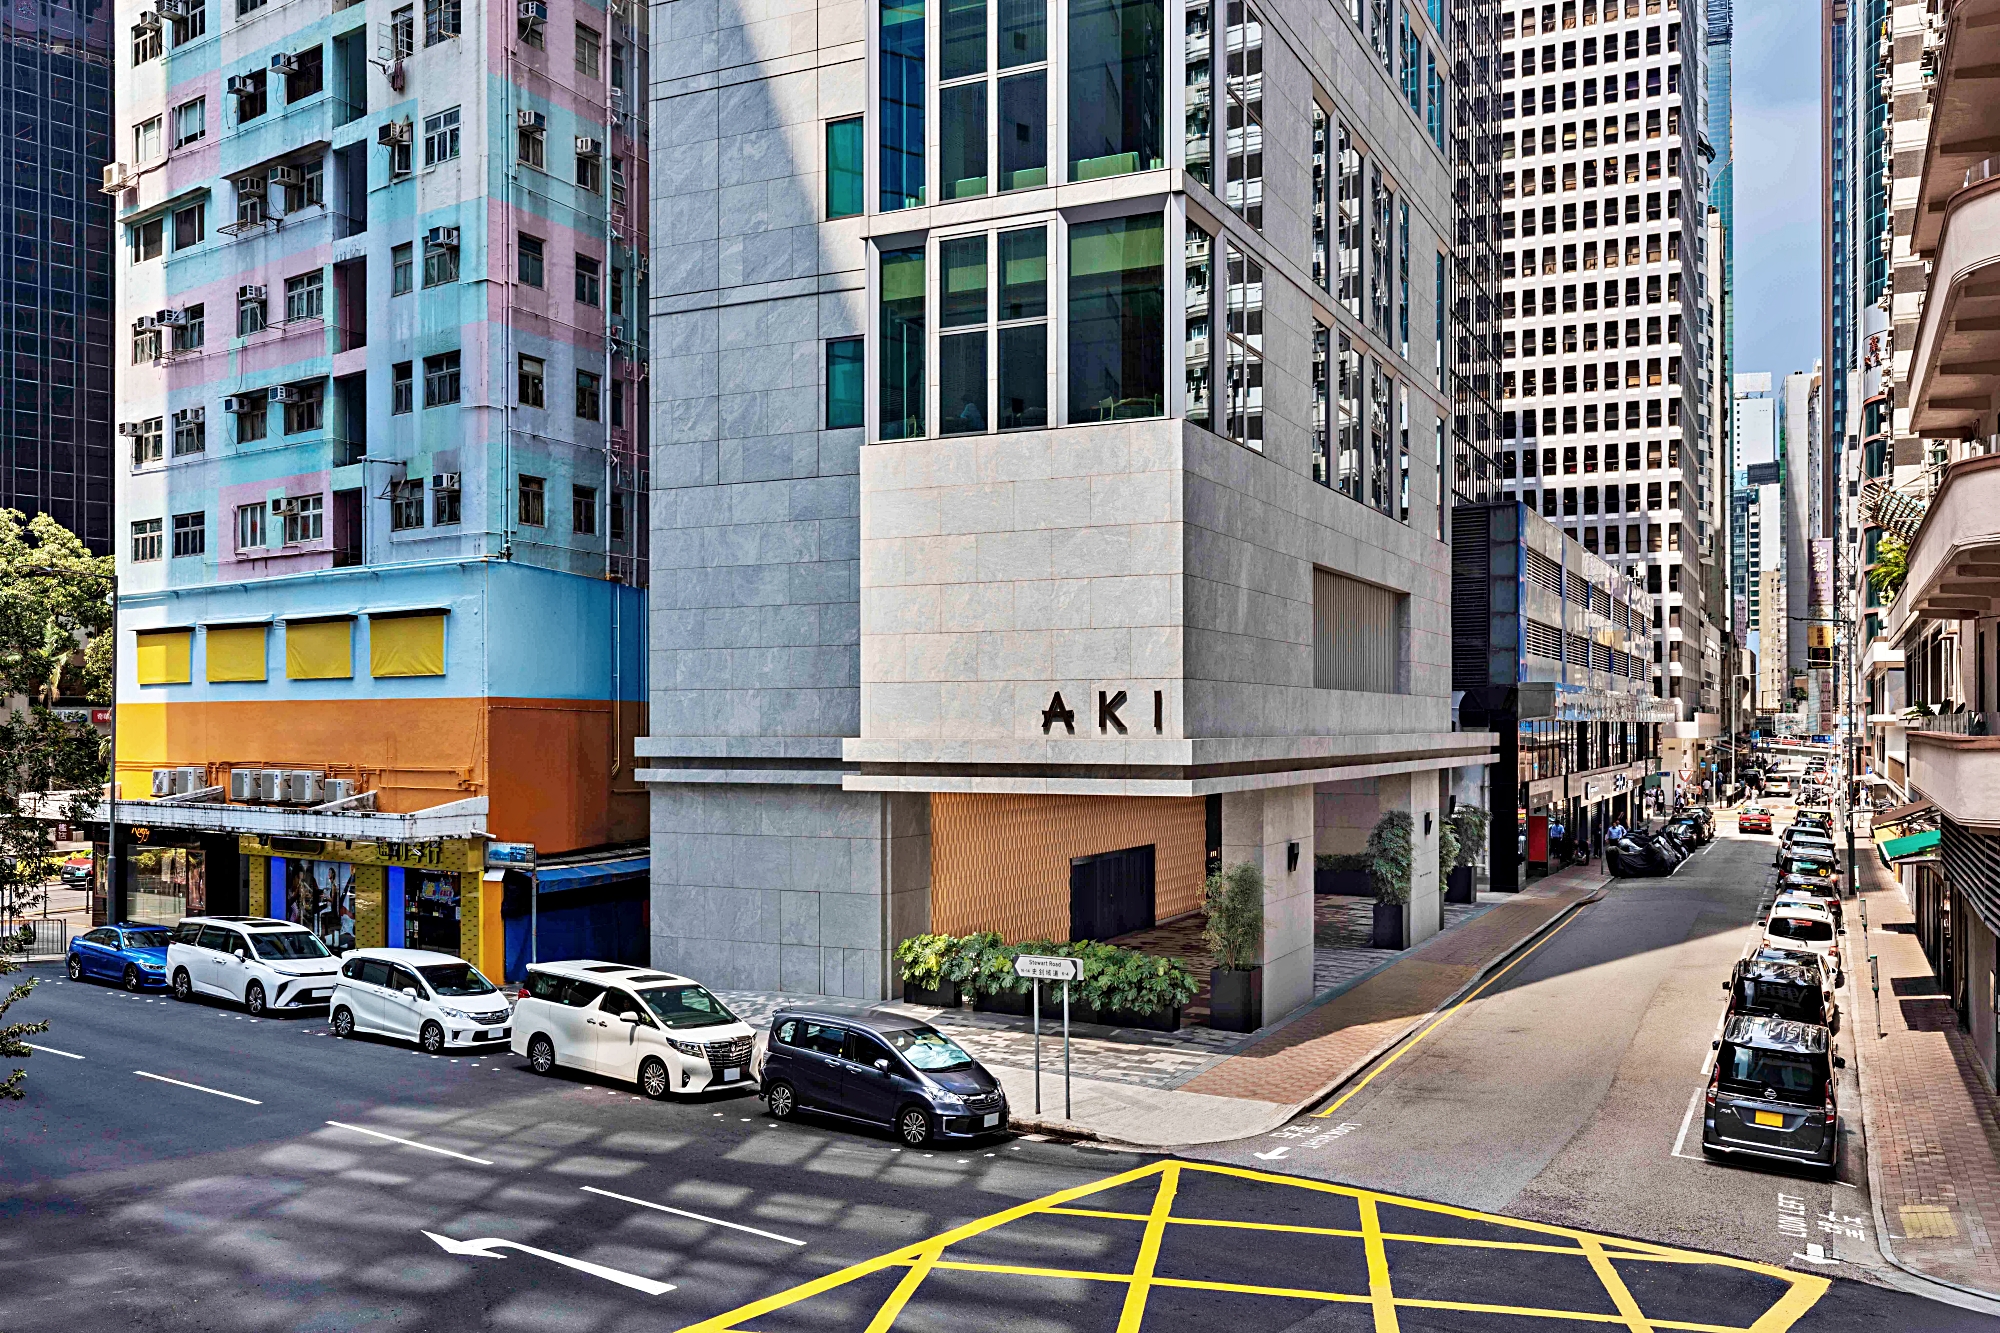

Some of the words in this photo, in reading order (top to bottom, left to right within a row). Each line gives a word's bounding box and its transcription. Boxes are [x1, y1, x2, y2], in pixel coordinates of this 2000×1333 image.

[1041, 690, 1163, 731] AKI
[1029, 959, 1048, 967] Stewart
[1778, 1192, 1806, 1216] LEFT
[1778, 1214, 1808, 1238] LOOK
